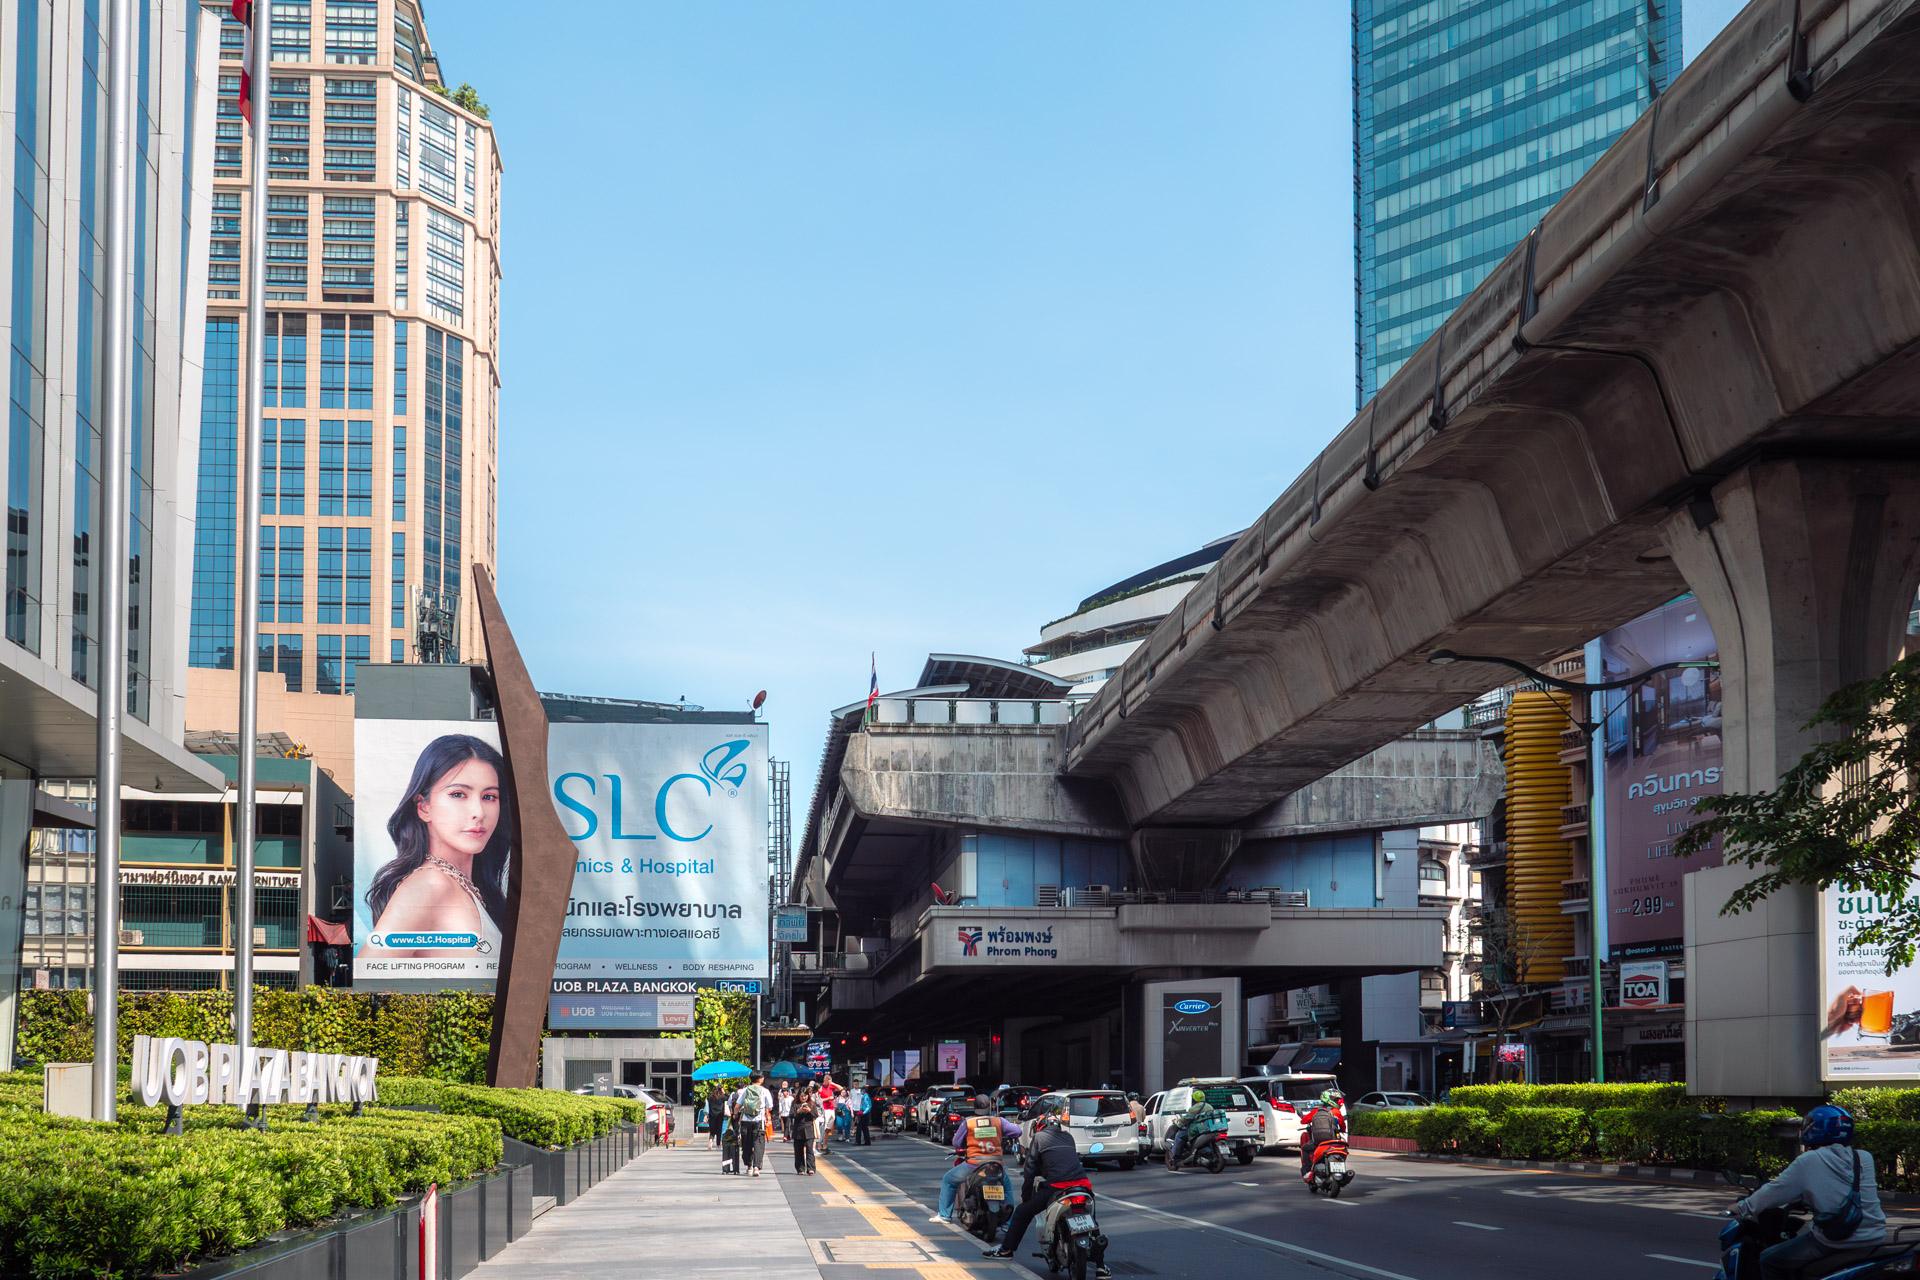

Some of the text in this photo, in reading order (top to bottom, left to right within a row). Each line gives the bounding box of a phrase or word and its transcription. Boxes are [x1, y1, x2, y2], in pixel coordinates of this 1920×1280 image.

[1629, 766, 1723, 800] ควินทาร
[553, 772, 713, 842] SLC
[576, 858, 714, 877] nics & Hospital
[254, 875, 298, 886] RNITURE
[1633, 896, 1663, 916] 2.99
[392, 936, 471, 945] www.SLC.Hospital
[987, 926, 1053, 943] พร้อมพงษ์
[987, 947, 1057, 958] Phrom Phong
[554, 981, 696, 993] UOB PLAZA BANGKOK
[1625, 983, 1657, 997] TOA
[571, 1007, 595, 1016] UOB
[131, 1034, 209, 1107] UOB
[290, 1051, 379, 1103] BANGKOK
[978, 1141, 995, 1153] 16
